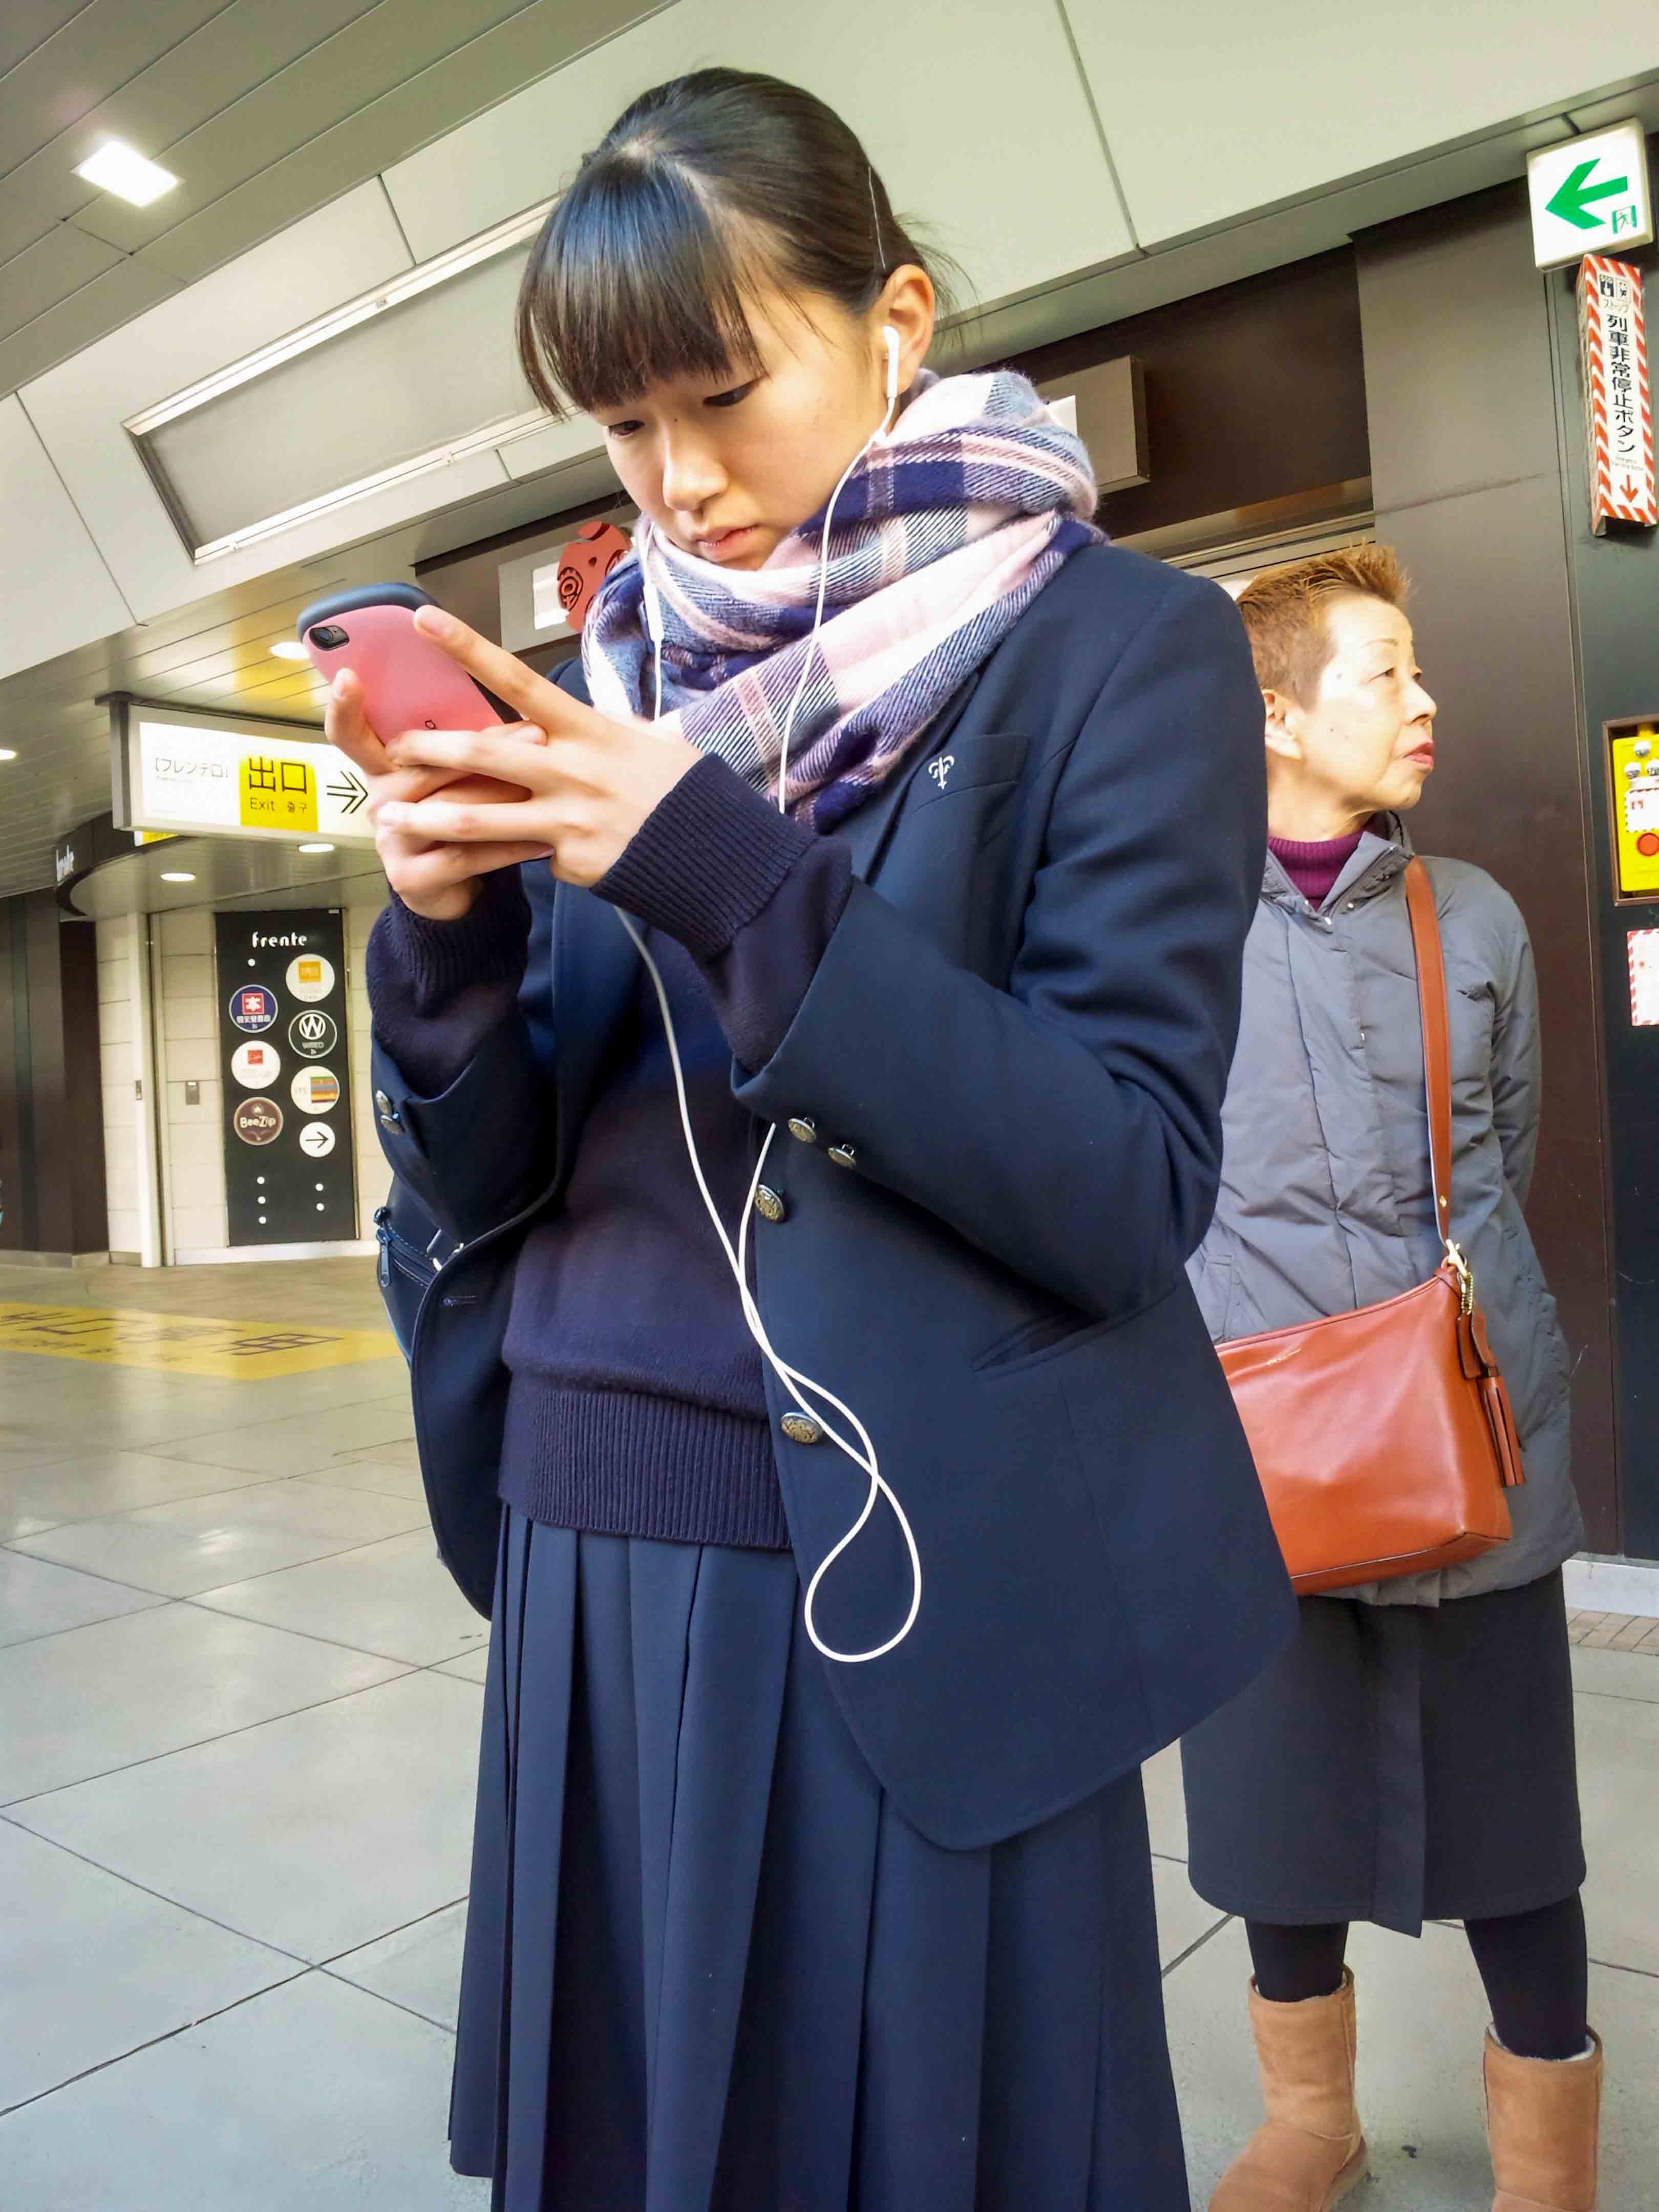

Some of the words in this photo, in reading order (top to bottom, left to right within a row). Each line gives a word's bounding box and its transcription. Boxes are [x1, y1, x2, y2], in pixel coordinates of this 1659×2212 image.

[1606, 314, 1635, 453] 列車非常停止ボタン
[249, 755, 308, 794] 出口
[250, 797, 274, 812] Exit
[252, 931, 308, 948] frente
